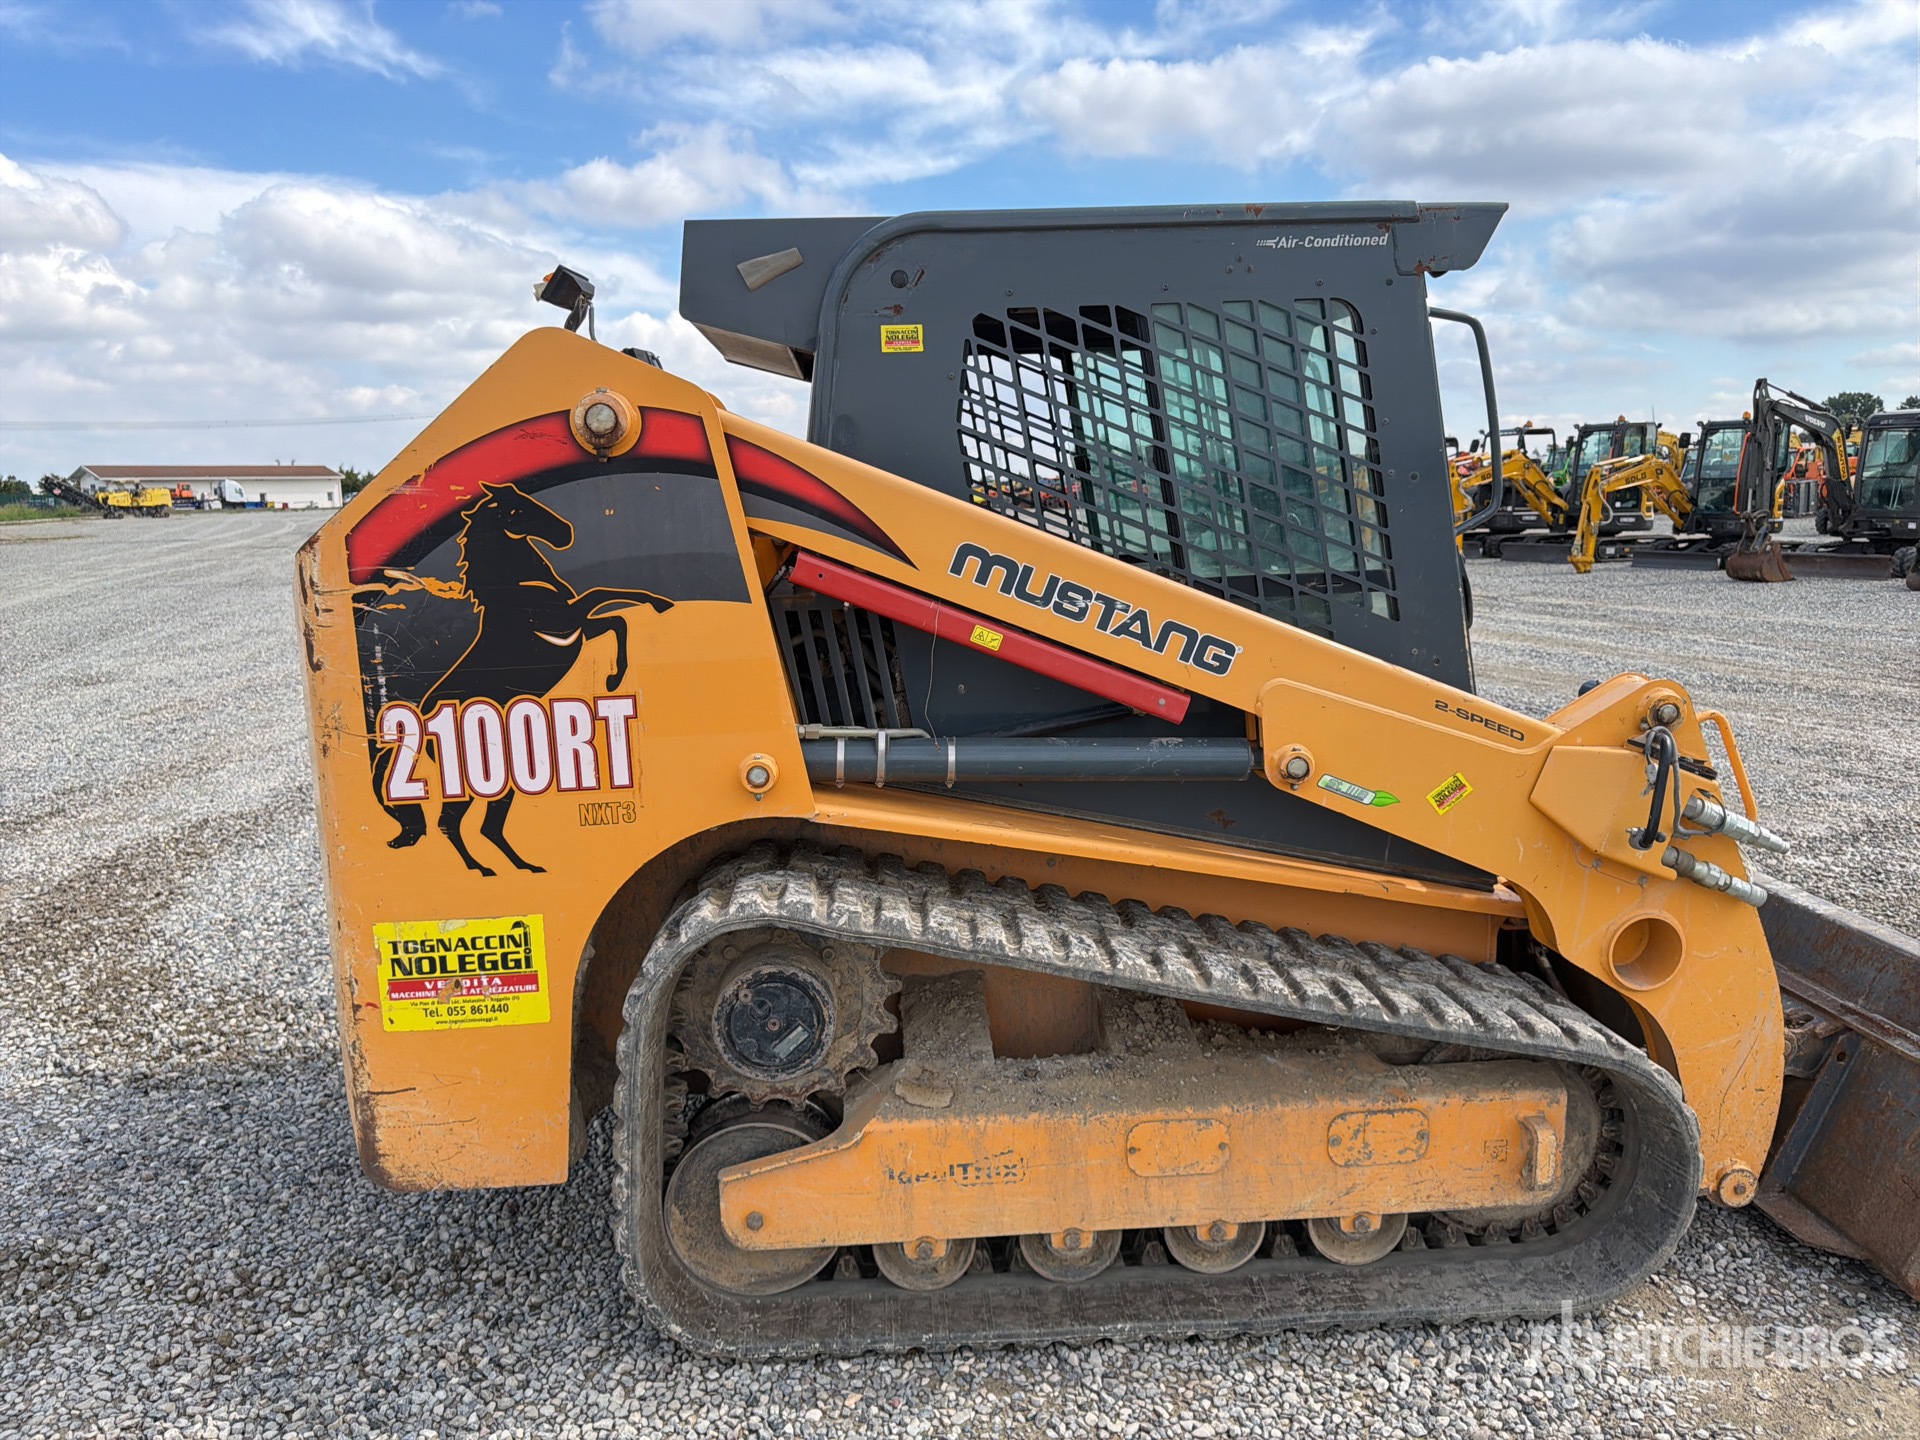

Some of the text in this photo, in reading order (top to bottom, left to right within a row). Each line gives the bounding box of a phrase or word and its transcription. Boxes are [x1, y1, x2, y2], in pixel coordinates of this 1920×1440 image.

[1277, 233, 1388, 248] Air-Conditioned
[1804, 414, 1826, 429] VOLVO
[948, 542, 1237, 677] MUSTANG
[1435, 699, 1525, 742] 2-SPEED
[379, 694, 638, 801] 2100RT
[578, 801, 637, 826] NXT3
[388, 931, 530, 955] TOGNACCINI
[424, 977, 502, 989] VEDITA
[391, 990, 436, 999] MACCHINE
[422, 1003, 509, 1018] Tel. 055 861440
